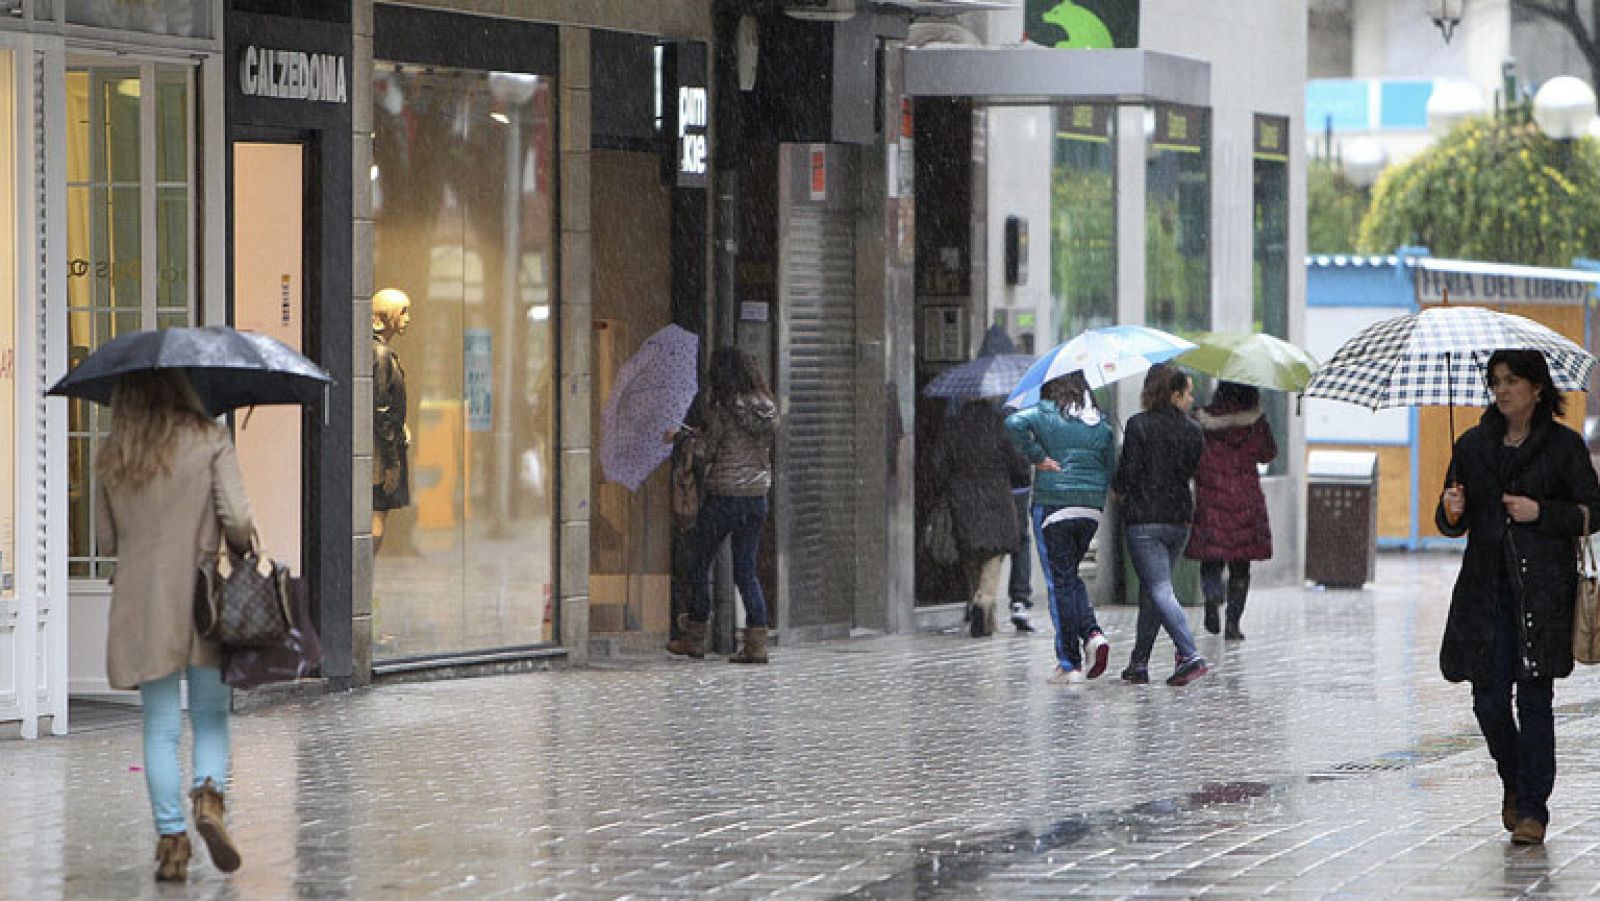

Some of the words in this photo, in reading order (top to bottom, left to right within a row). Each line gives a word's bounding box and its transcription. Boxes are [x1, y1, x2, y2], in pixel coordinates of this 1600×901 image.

[241, 45, 347, 103] CALZEDONIA
[1482, 273, 1520, 298] DEL
[1524, 277, 1584, 300] LIBRO
